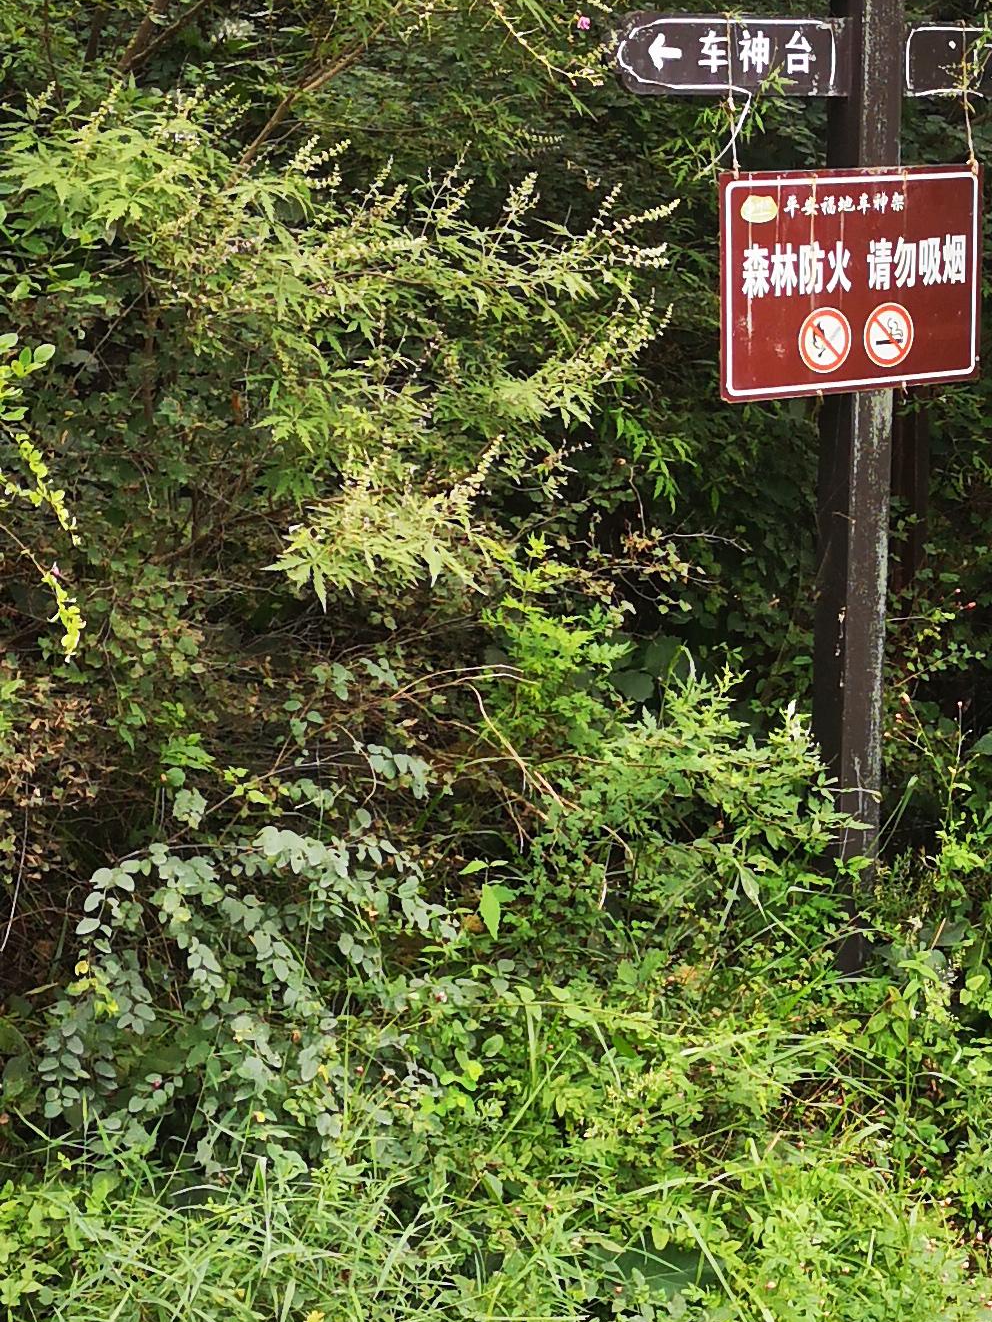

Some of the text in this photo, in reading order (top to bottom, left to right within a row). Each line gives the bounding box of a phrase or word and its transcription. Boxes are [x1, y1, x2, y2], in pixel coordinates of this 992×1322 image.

[698, 30, 812, 74] 车神台
[784, 192, 904, 218] 平安福地车神架
[742, 234, 967, 298] 森林防火 请勿吸烟
